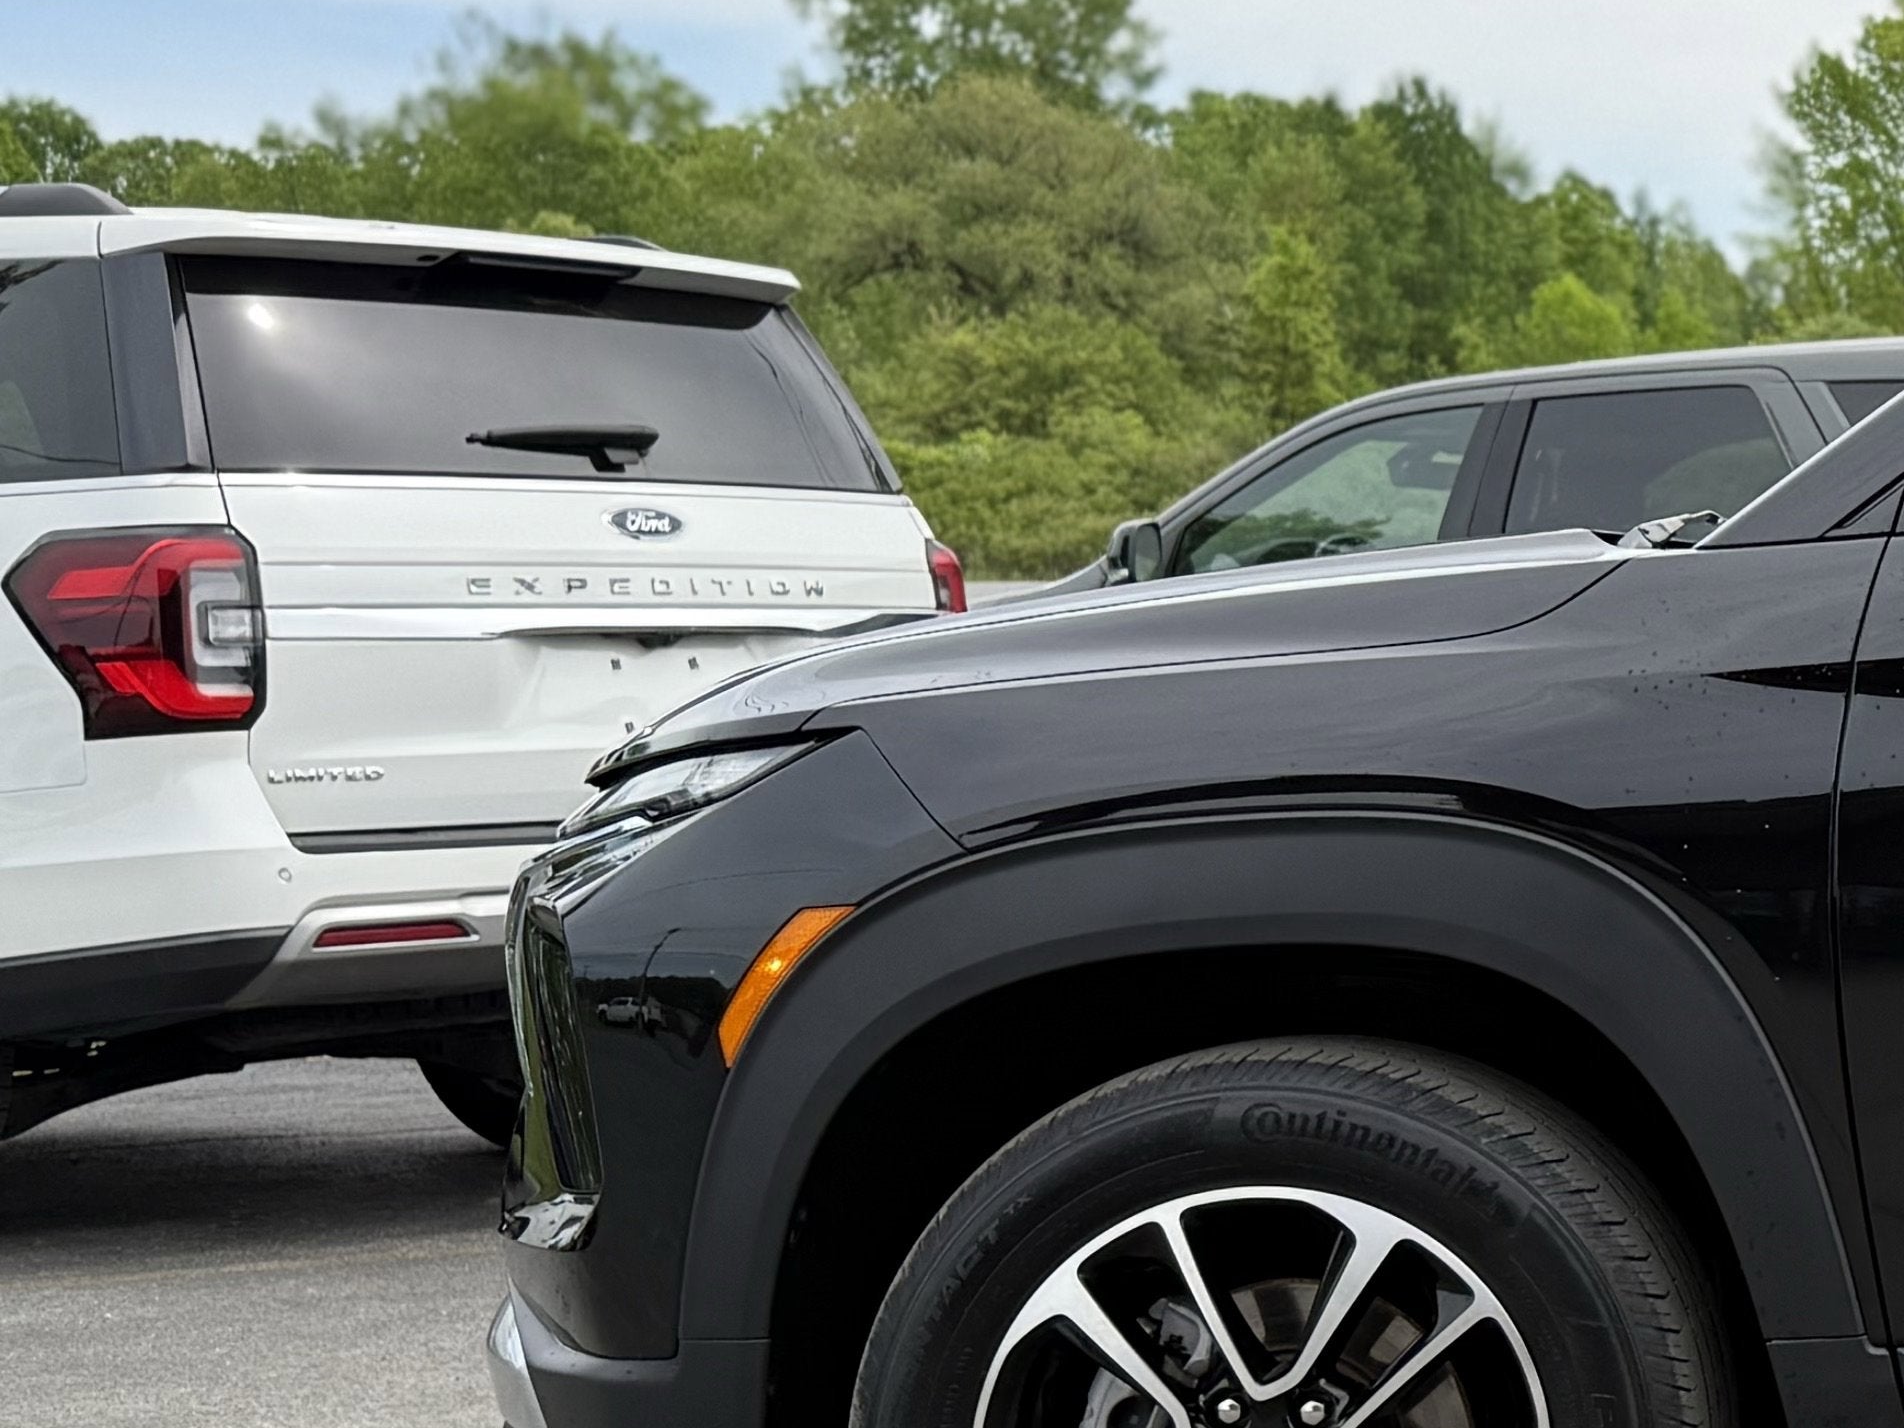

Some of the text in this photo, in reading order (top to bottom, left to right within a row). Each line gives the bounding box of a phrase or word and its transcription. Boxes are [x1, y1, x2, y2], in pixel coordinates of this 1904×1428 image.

[625, 510, 673, 534] Ford
[466, 576, 824, 599] EXPEDITION
[267, 765, 385, 785] LIMITED
[1240, 1102, 1477, 1199] Continental
